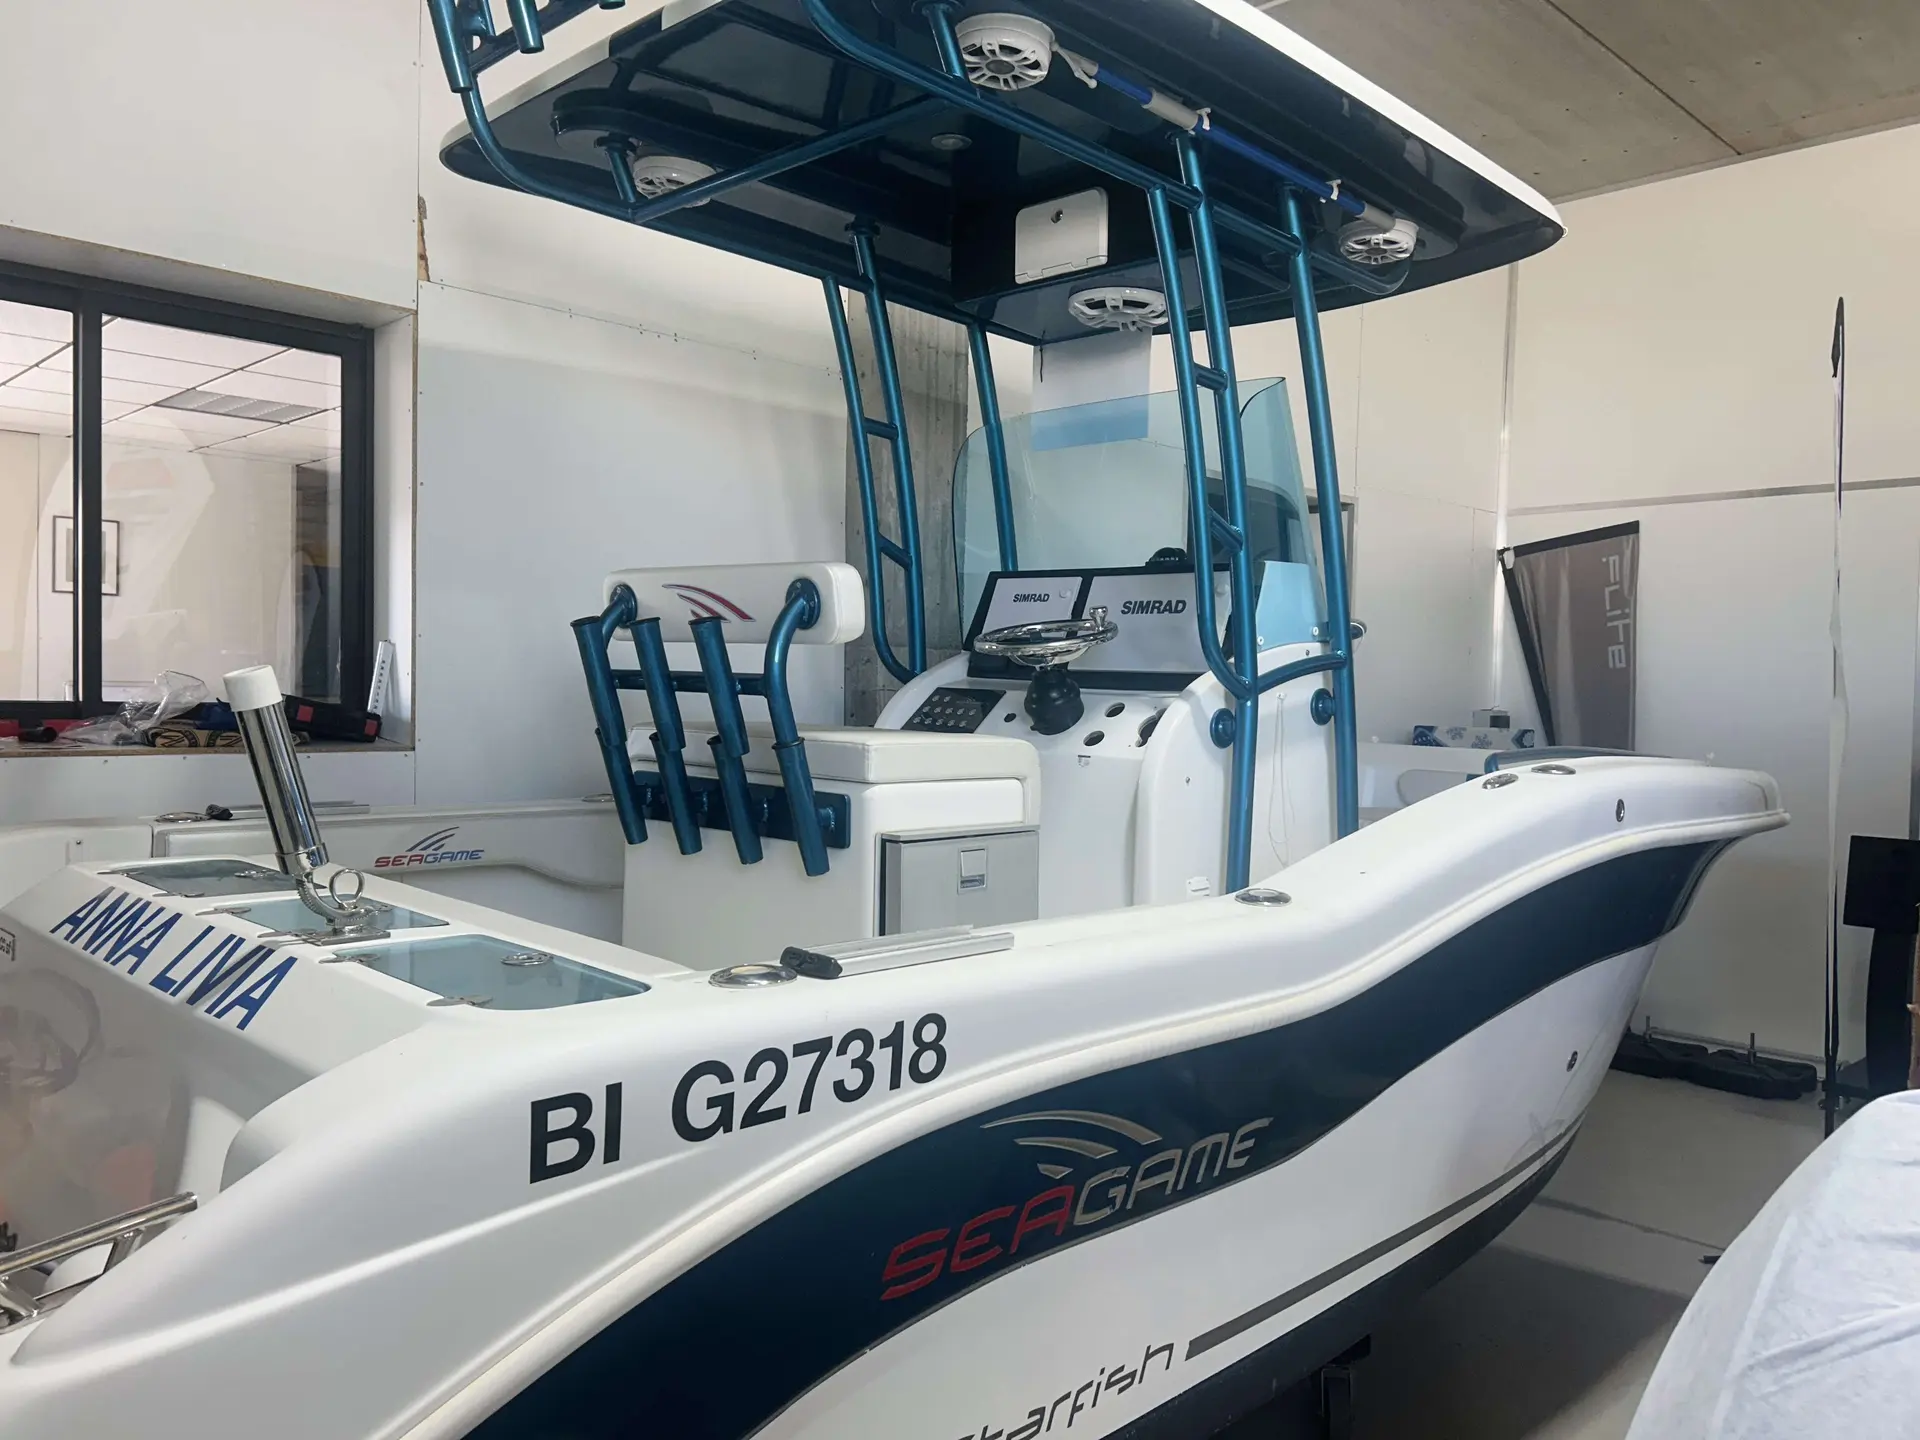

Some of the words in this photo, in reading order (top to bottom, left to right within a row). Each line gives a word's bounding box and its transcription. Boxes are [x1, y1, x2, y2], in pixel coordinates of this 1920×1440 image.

[1012, 593, 1050, 603] SIMRAD
[1120, 599, 1187, 615] SIMRAD
[374, 849, 485, 868] SEAGAME
[49, 885, 183, 975] ANNA
[149, 924, 298, 1031] LIVIA
[529, 1081, 623, 1184] BI
[671, 1012, 948, 1143] G27318
[881, 1117, 1274, 1300] SEAGAME
[958, 1342, 1175, 1440] arfish
